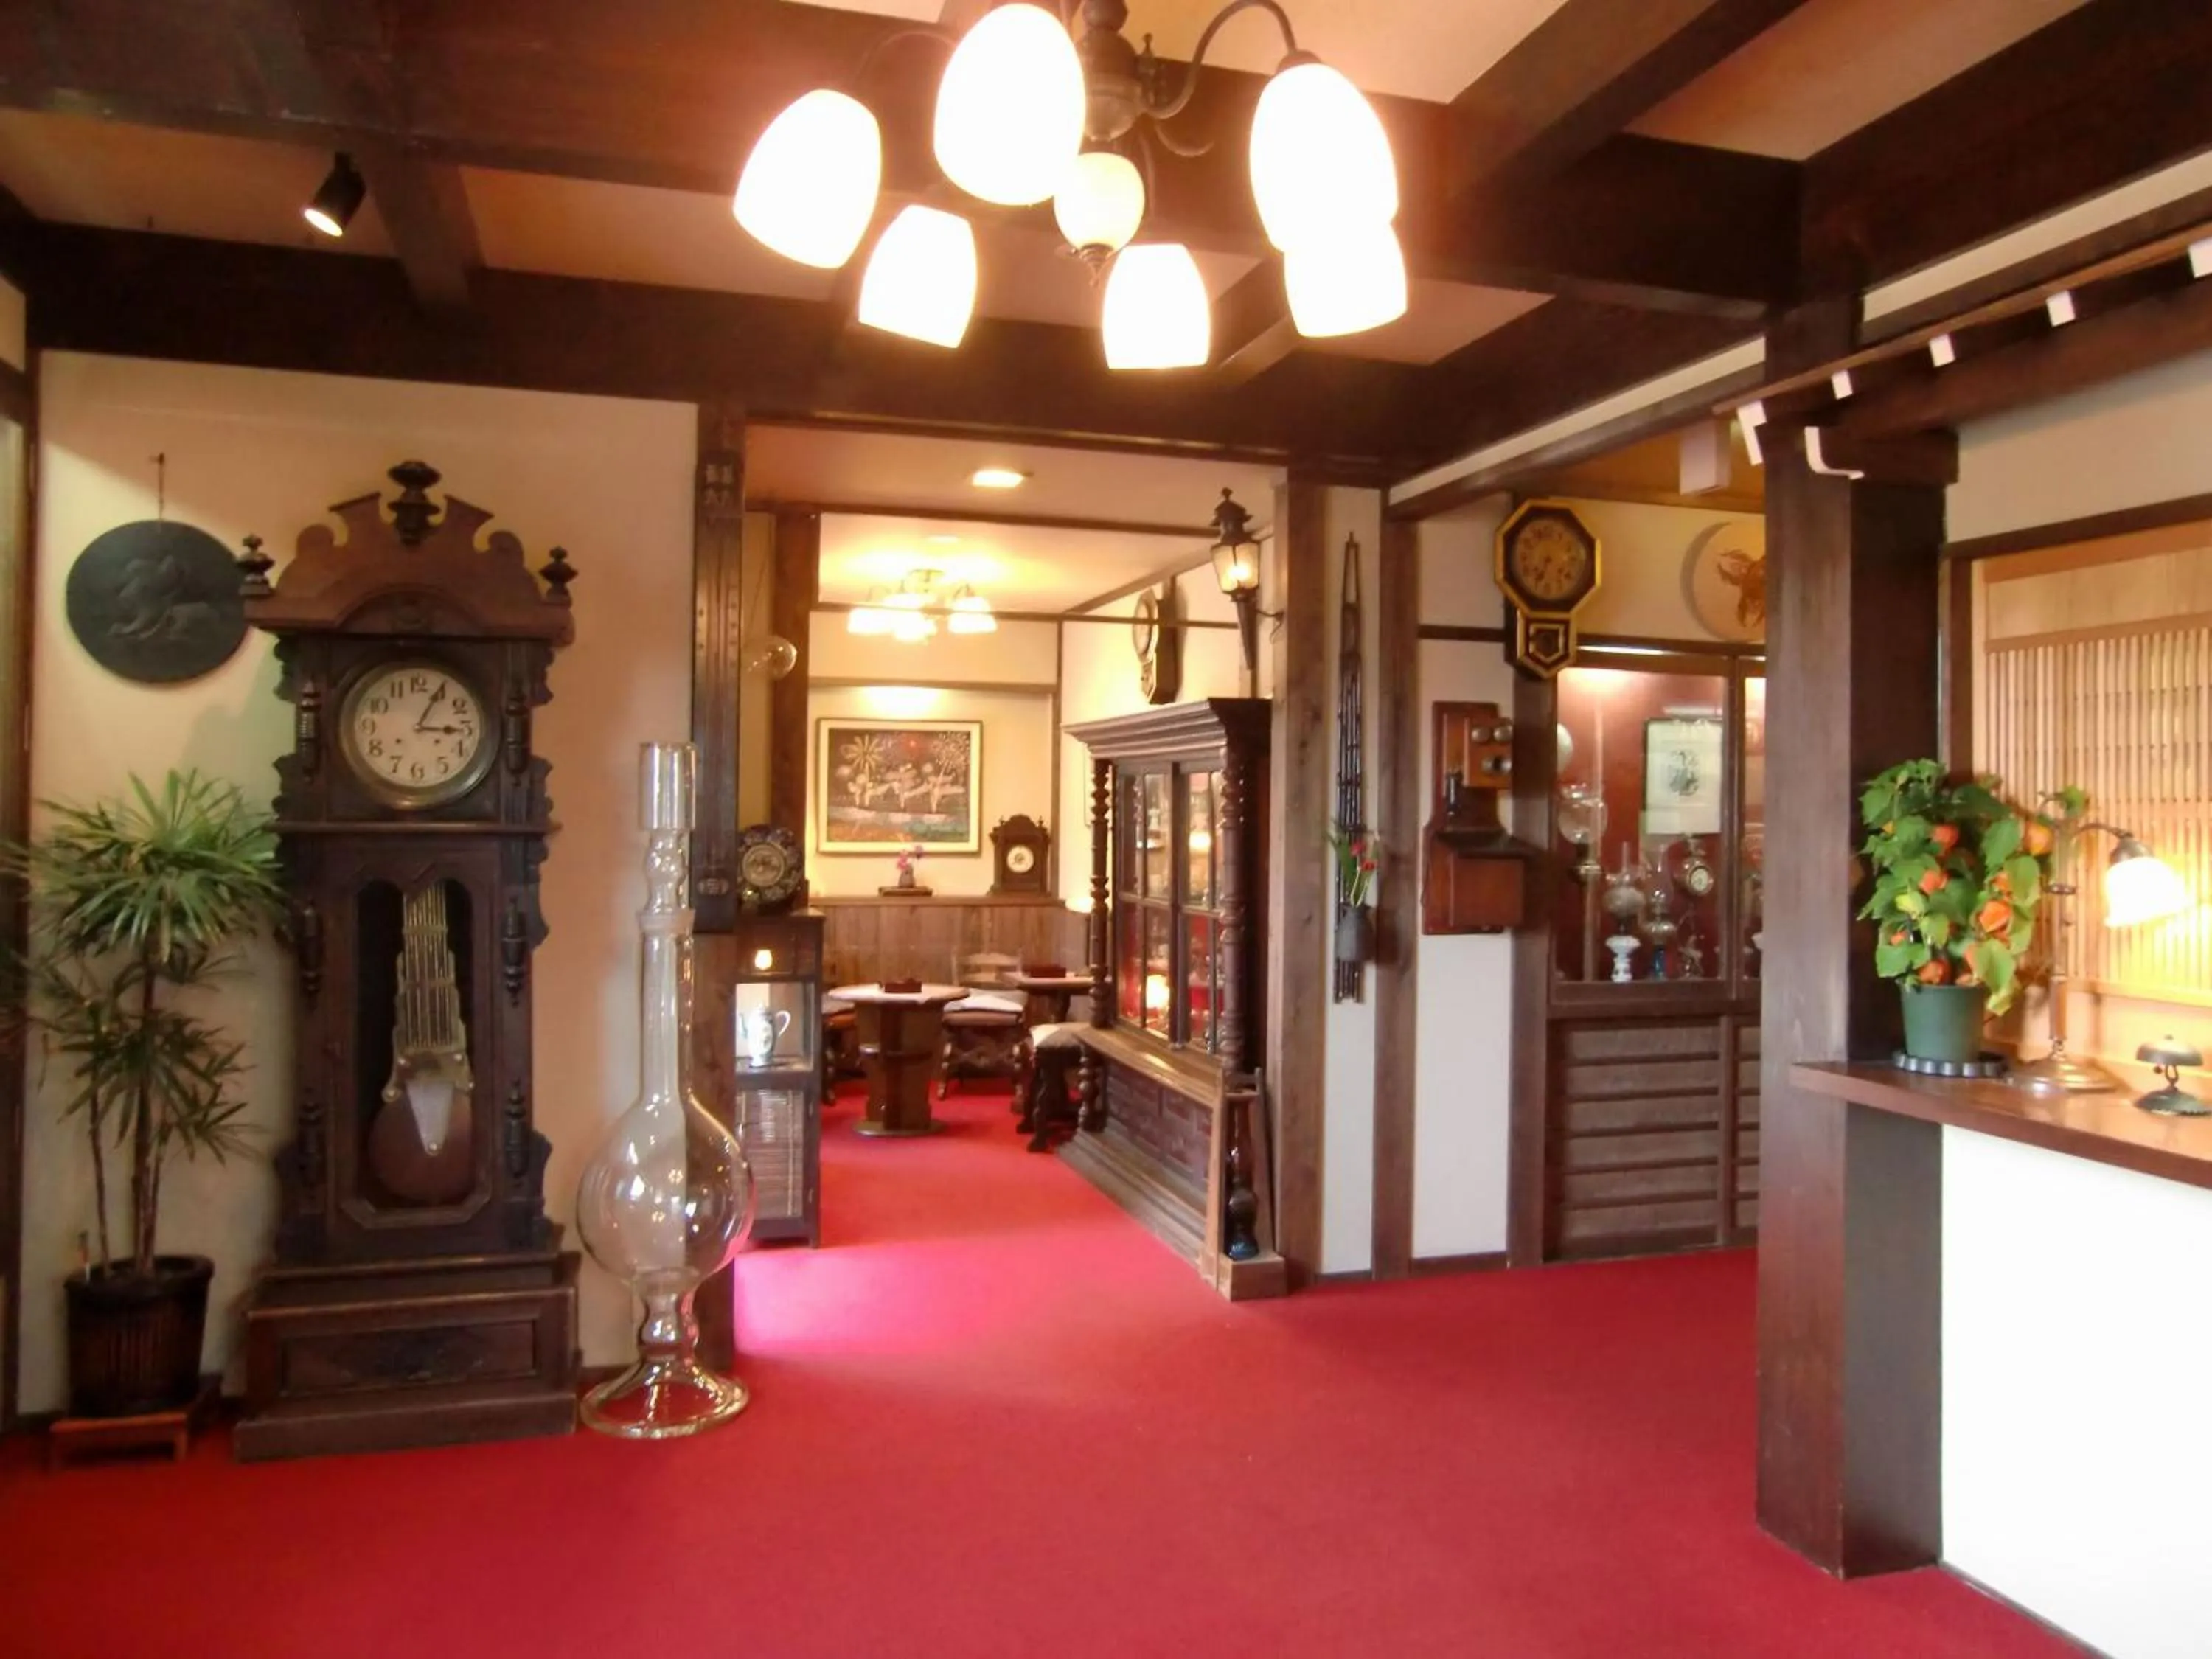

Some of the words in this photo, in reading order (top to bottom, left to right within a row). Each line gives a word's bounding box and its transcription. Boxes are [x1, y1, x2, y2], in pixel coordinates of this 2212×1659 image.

[390, 681, 404, 699] 11
[411, 675, 428, 693] 12
[369, 698, 389, 714] 10
[452, 698, 467, 714] 2
[361, 717, 376, 736] 9
[460, 720, 473, 737] 3
[369, 739, 383, 757] 8
[389, 754, 403, 773] 7
[410, 762, 425, 780] 6
[436, 756, 450, 774] 5
